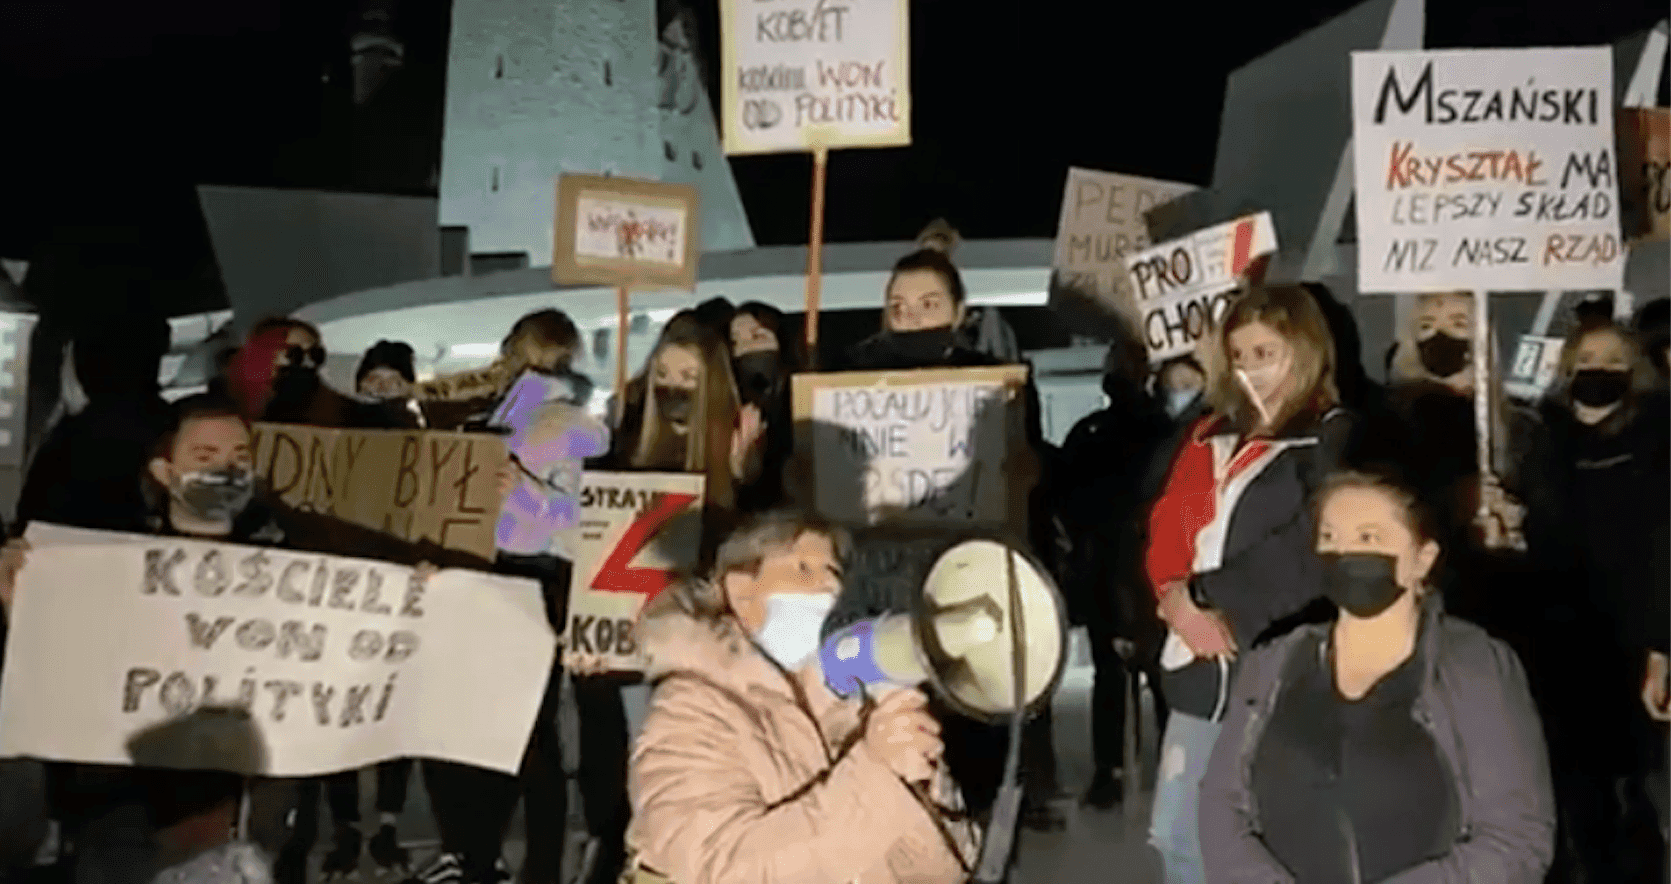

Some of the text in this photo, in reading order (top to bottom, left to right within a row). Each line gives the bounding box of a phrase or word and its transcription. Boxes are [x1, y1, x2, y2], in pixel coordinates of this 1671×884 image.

[816, 59, 886, 89] WON
[1374, 59, 1598, 125] MSZAŃSKI
[1386, 140, 1547, 190] KRYSZTAŁ
[1560, 149, 1613, 190] MA
[1391, 190, 1612, 225] LEPSZY SKŁAD
[1130, 247, 1192, 300] PRO
[1452, 237, 1529, 267] NASZ
[394, 435, 485, 513] BYŁ
[141, 549, 426, 617] KOŚCIELE
[185, 612, 421, 665] WON OD
